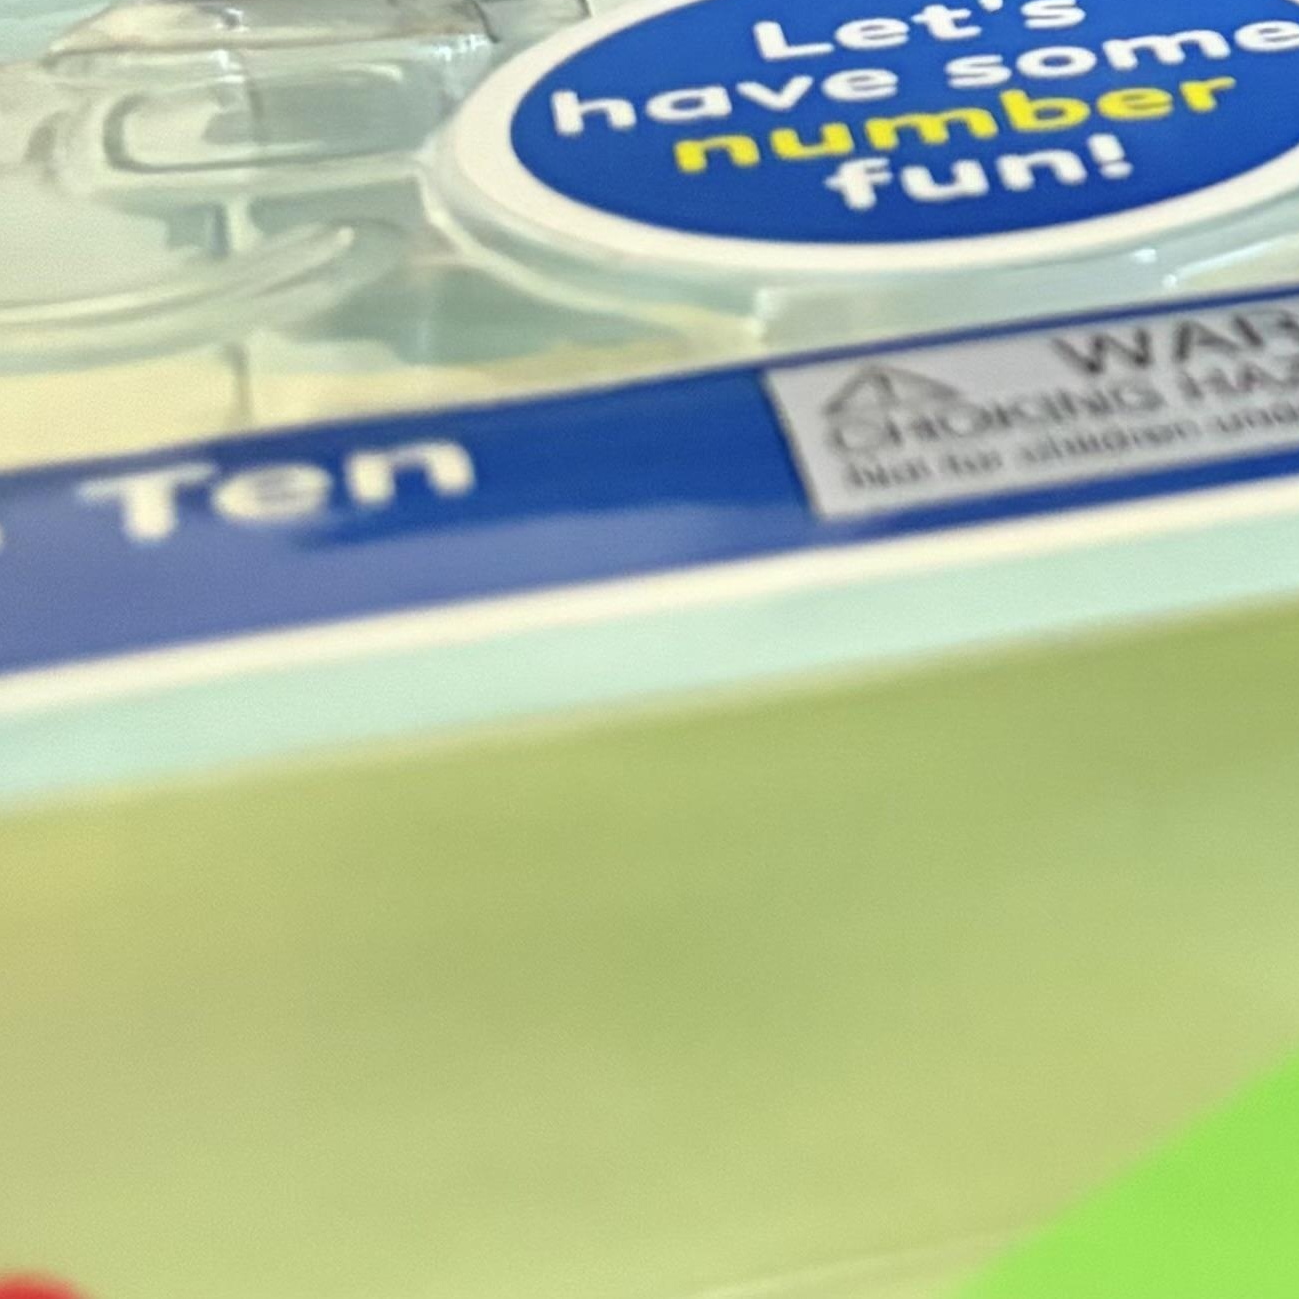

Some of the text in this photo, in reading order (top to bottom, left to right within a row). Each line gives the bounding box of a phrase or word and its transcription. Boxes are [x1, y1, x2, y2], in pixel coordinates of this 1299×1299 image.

[550, 67, 899, 137] have
[673, 75, 1237, 174] number
[824, 132, 1133, 211] fun!
[826, 381, 1166, 455] CHOKING
[76, 441, 474, 543] Ten
